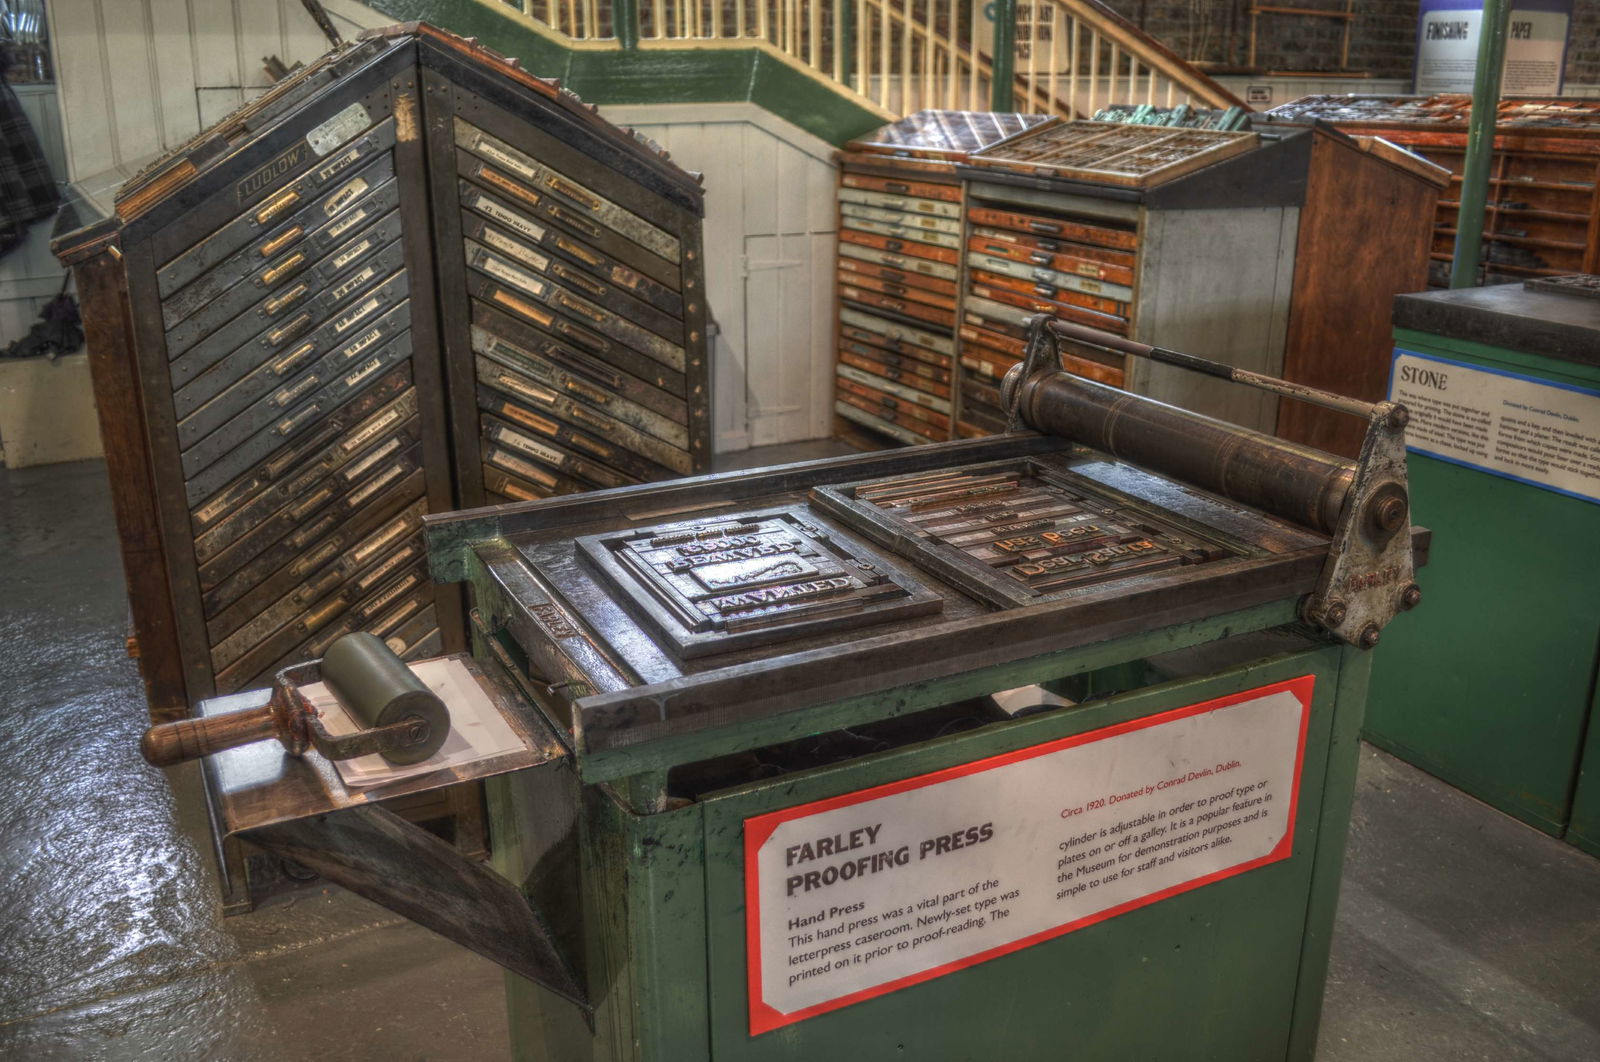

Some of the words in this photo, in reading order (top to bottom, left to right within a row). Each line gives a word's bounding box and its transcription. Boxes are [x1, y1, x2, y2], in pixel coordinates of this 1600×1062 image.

[1510, 22, 1532, 38] PAPER
[244, 150, 300, 195] LUDLOW
[495, 211, 513, 224] TEMPO
[513, 220, 531, 232] HEAVY
[1401, 365, 1448, 390] STONE
[522, 443, 540, 454] TEMPO
[540, 450, 557, 462] HEAVY
[1059, 832, 1097, 852] cylinder
[1100, 828, 1107, 838] is
[1109, 813, 1155, 835] adjustable
[1158, 810, 1166, 819] in
[1169, 801, 1195, 816] order
[1197, 798, 1207, 807] to
[1209, 788, 1235, 806] proof
[1236, 784, 1255, 797] type
[1258, 780, 1268, 789] or
[1061, 807, 1083, 818] Circa
[1086, 798, 1106, 811] 1920.
[1109, 787, 1144, 805] Donated
[1145, 784, 1155, 795] by
[1157, 775, 1186, 791] Conrad
[1188, 768, 1213, 781] Devlin,
[1215, 760, 1242, 773] Dublin.
[786, 823, 882, 867] FARLEY
[786, 846, 909, 897] PROOFING
[919, 822, 994, 860] PRESS
[1057, 872, 1073, 883] the
[1076, 858, 1116, 877] Museum
[1118, 852, 1132, 864] for
[1134, 831, 1200, 858] demonstration
[1202, 818, 1241, 838] purposes
[1243, 810, 1260, 823] and
[1261, 809, 1268, 818] is
[1058, 851, 1086, 869] plates
[1089, 847, 1101, 857] on
[1104, 842, 1116, 852] or
[1118, 834, 1132, 847] off
[1140, 827, 1167, 843] galley.
[1170, 821, 1177, 831] It
[1179, 819, 1186, 828] is
[1196, 806, 1230, 826] popular
[1232, 797, 1262, 812] feature
[1264, 793, 1272, 802] in
[1056, 883, 1087, 900] simple
[1089, 879, 1100, 888] to
[1102, 873, 1119, 884] use
[1121, 867, 1135, 878] for
[1137, 857, 1157, 872] staff
[1159, 851, 1175, 865] and
[1177, 843, 1208, 858] visitors
[1210, 836, 1232, 849] alike.
[788, 934, 813, 949] This
[817, 922, 844, 940] hand
[848, 914, 878, 934] press
[882, 909, 904, 922] was
[907, 905, 914, 915] a
[917, 894, 939, 911] vital
[942, 889, 965, 905] part
[968, 883, 980, 897] of
[982, 878, 999, 893] the
[788, 911, 825, 931] Hand
[830, 902, 865, 921] Press
[788, 939, 851, 966] letterpress
[855, 922, 913, 945] caseroom.
[916, 904, 972, 928] Newly-set
[974, 895, 998, 912] type
[1000, 888, 1020, 901] was
[788, 963, 831, 987] printed
[834, 957, 850, 969] on
[853, 949, 862, 964] it
[865, 944, 894, 964] prior
[897, 940, 909, 951] to
[912, 917, 987, 950] proof-reading.
[990, 907, 1010, 922] The
